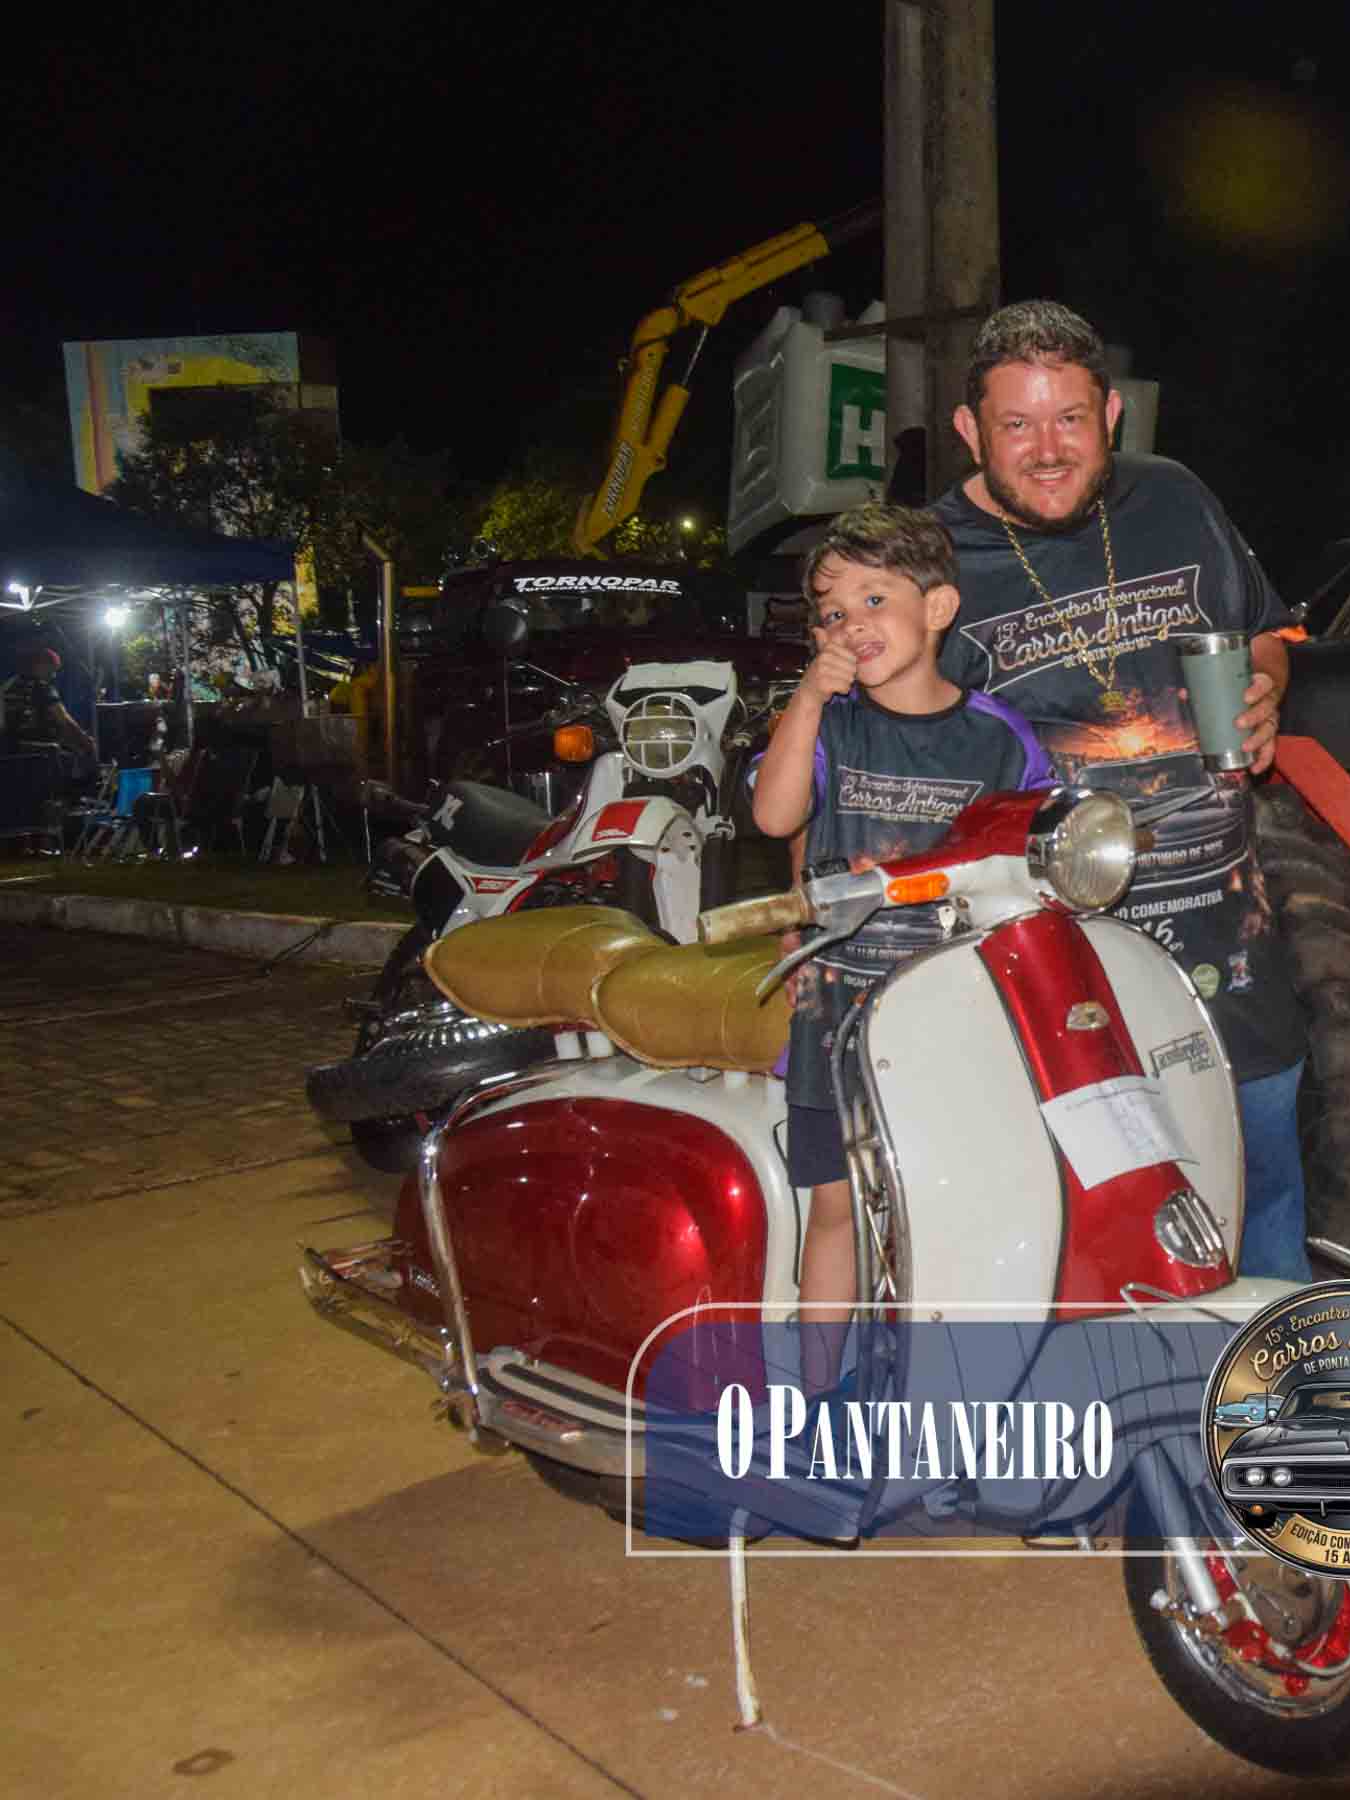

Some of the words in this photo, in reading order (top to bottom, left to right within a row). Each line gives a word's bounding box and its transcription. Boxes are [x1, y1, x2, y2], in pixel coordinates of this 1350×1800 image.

[513, 575, 681, 590] TORNOPAR
[1024, 600, 1091, 630] Encontro
[1092, 577, 1186, 611] Internacional
[994, 626, 1090, 671] Carros
[1095, 602, 1200, 645] Antigos
[839, 784, 896, 811] Carros
[1131, 889, 1225, 920] COMEMORATIVA
